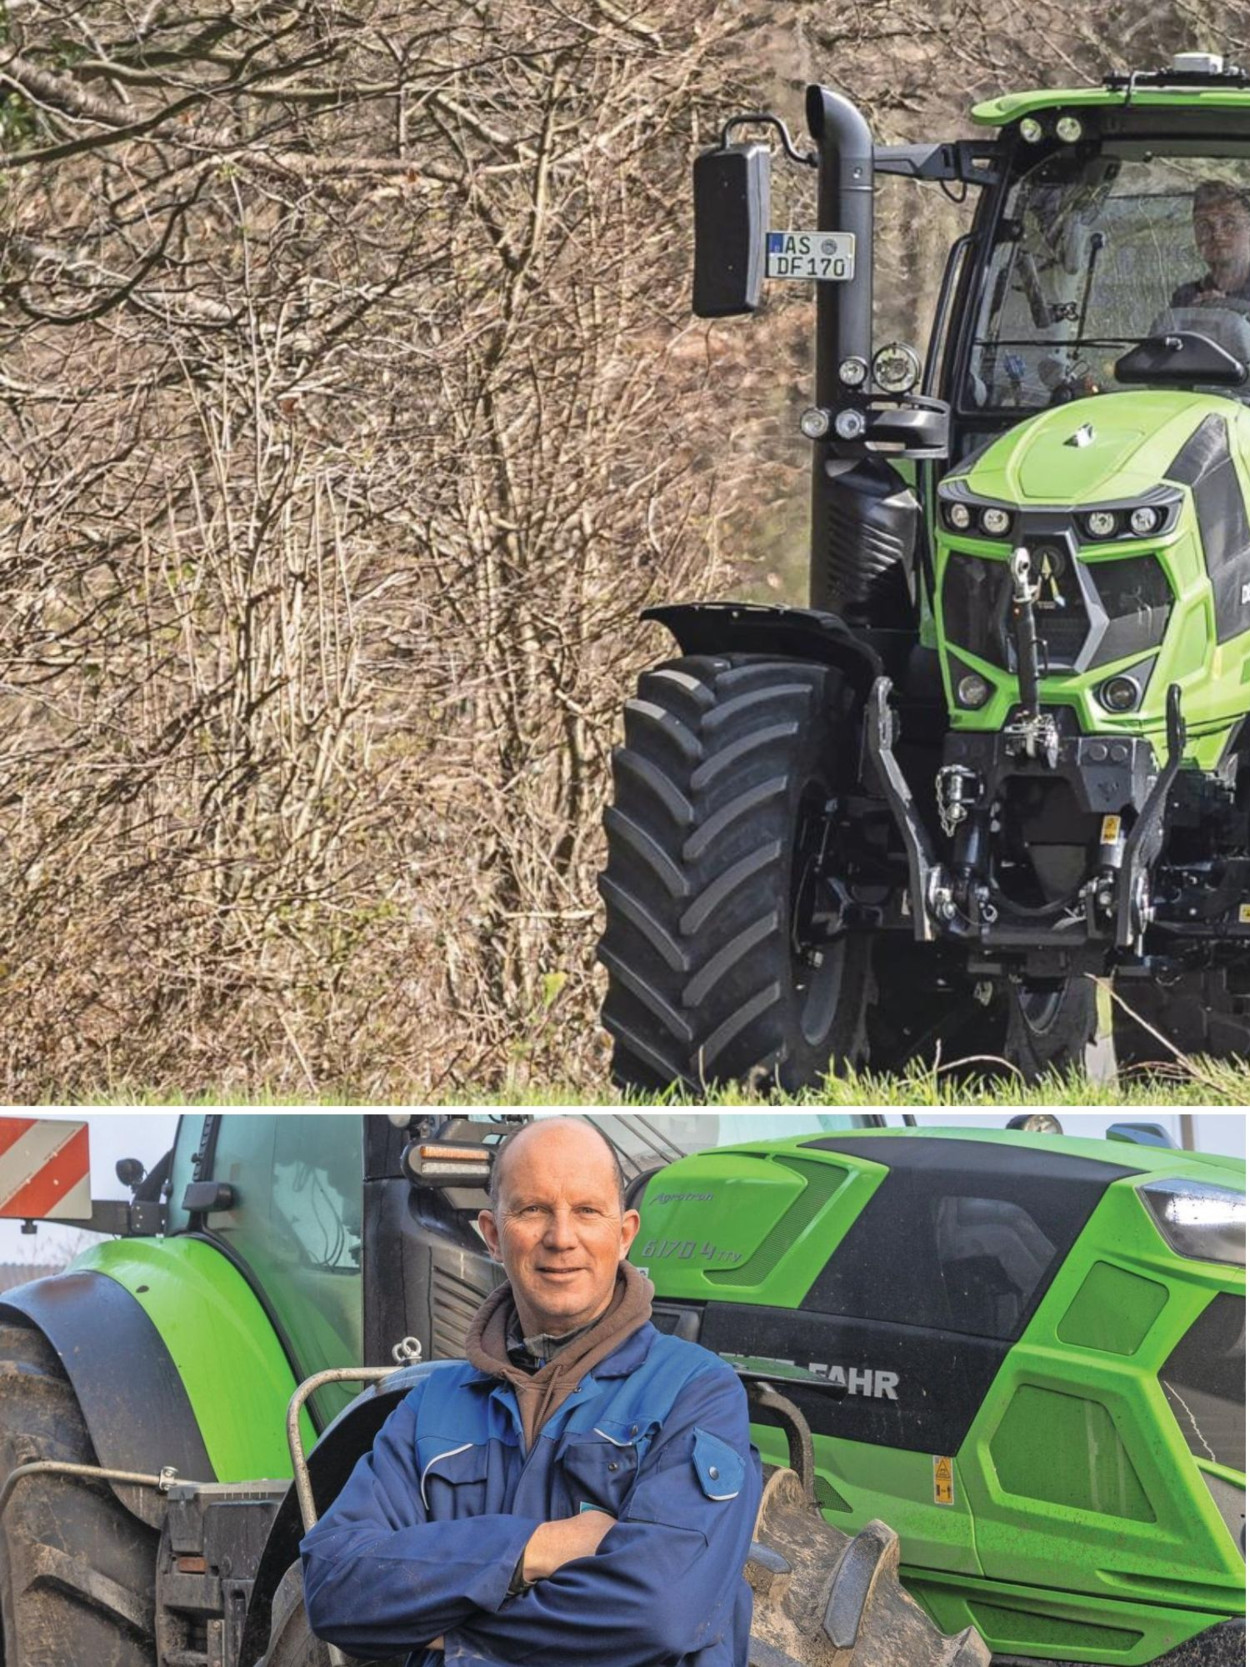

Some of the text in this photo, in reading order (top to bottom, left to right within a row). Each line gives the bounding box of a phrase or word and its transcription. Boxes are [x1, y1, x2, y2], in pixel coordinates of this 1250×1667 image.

[785, 236, 811, 255] AS
[777, 257, 845, 277] DF 170
